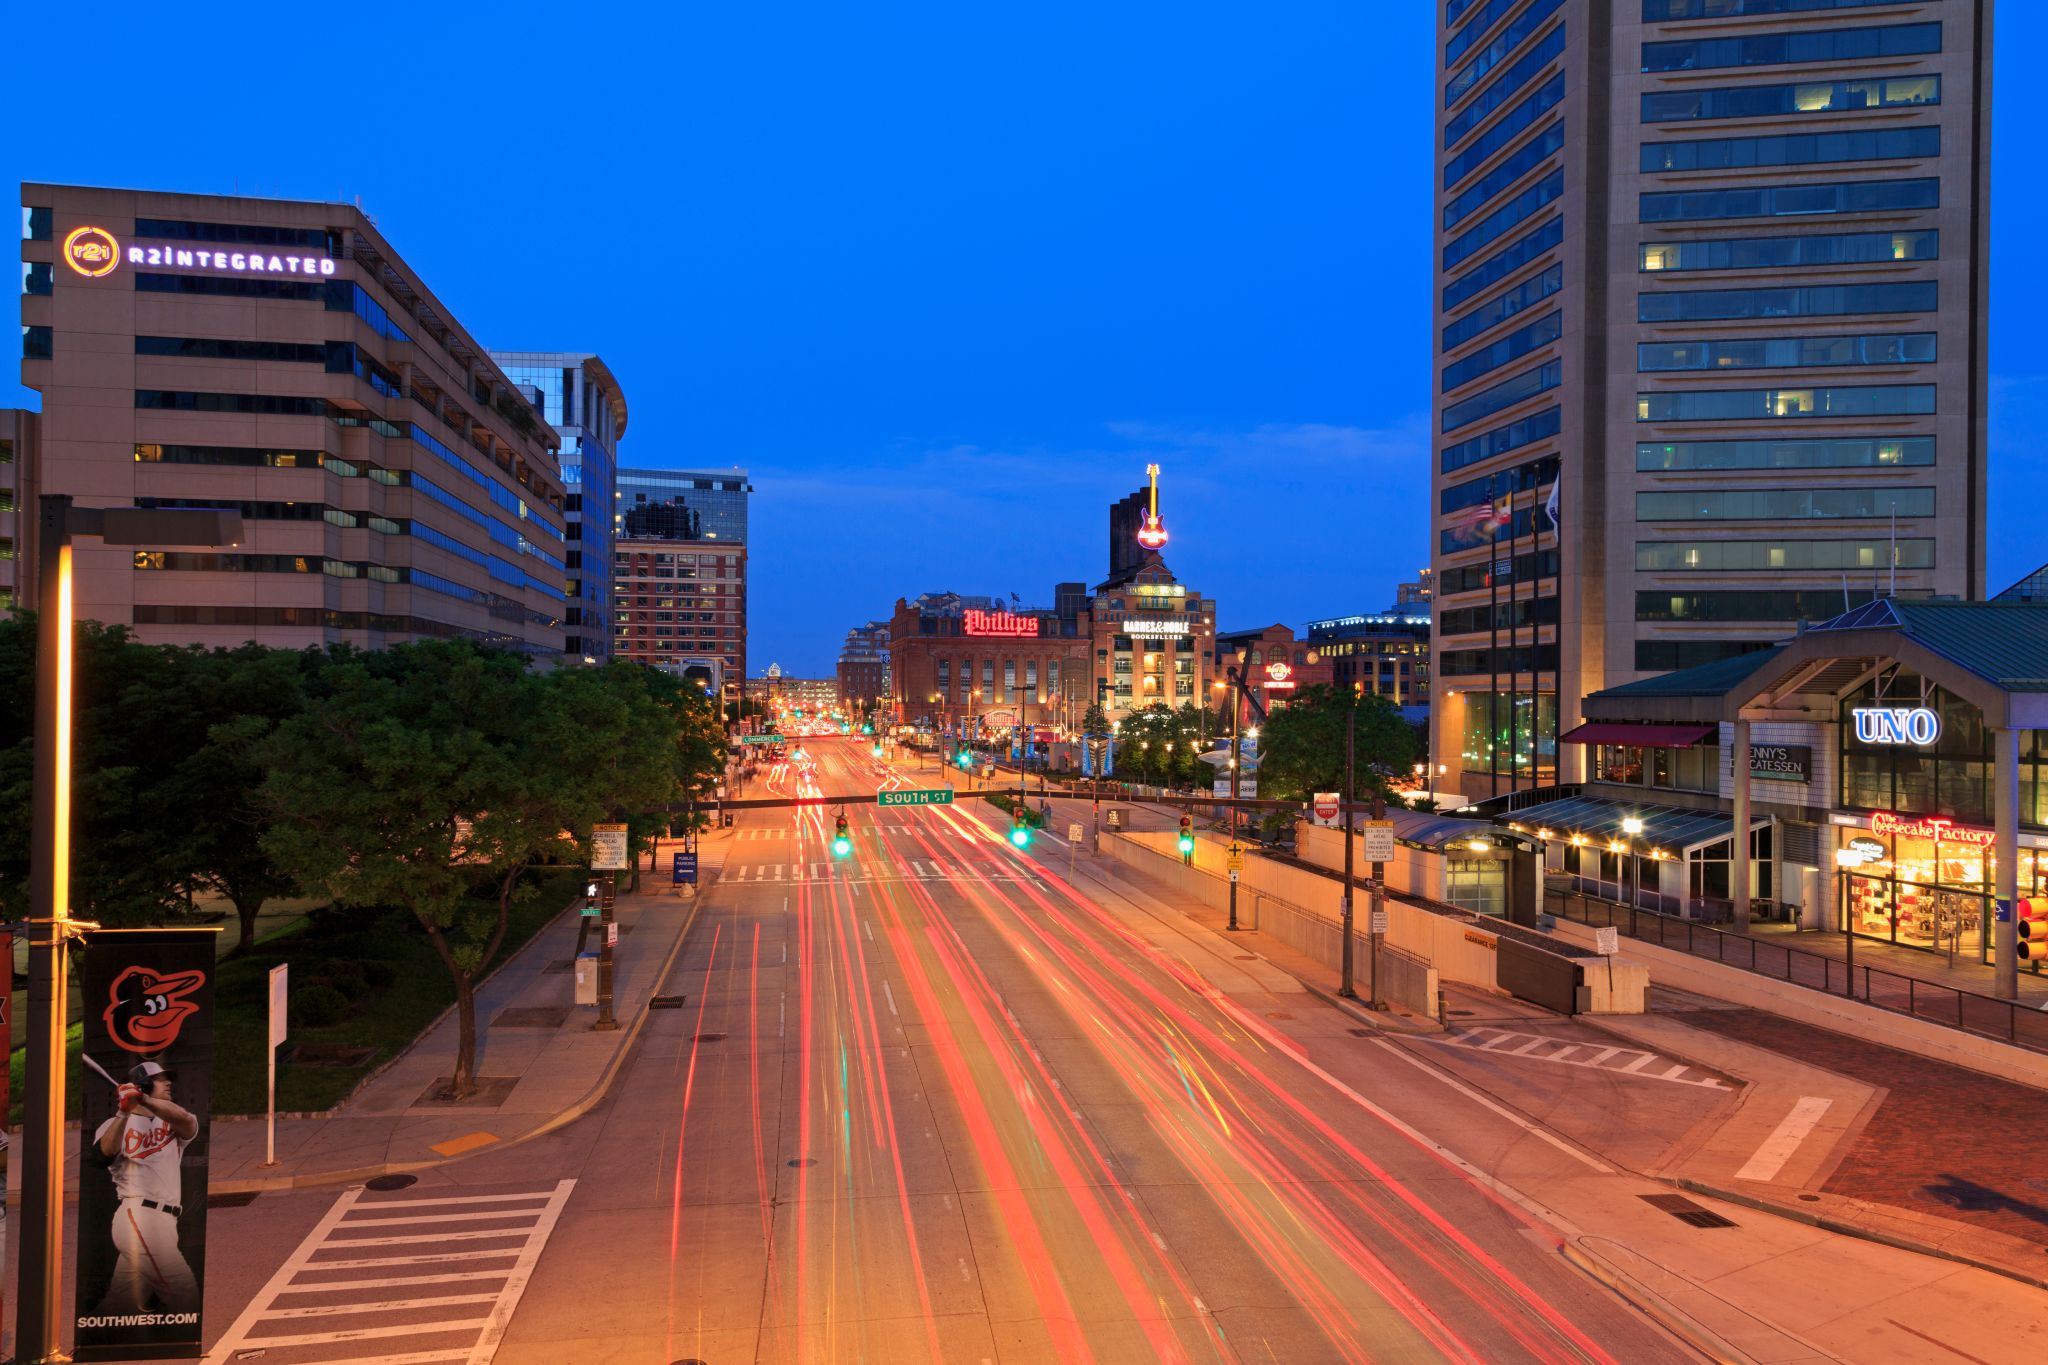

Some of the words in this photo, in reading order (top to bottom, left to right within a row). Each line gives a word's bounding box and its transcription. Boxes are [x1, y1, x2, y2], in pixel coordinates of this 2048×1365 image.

[73, 243, 110, 261] r2i
[964, 609, 1037, 635] Phillips
[1853, 708, 1937, 745] UNO
[1749, 746, 1787, 760] ENNY'S
[885, 792, 929, 803] SOUTH
[934, 792, 947, 802] ST
[1884, 814, 1896, 823] The
[1872, 813, 1934, 837] Cheesecake
[1927, 818, 1996, 848] Factory
[77, 1313, 197, 1328] SOUTHWEST.COM
